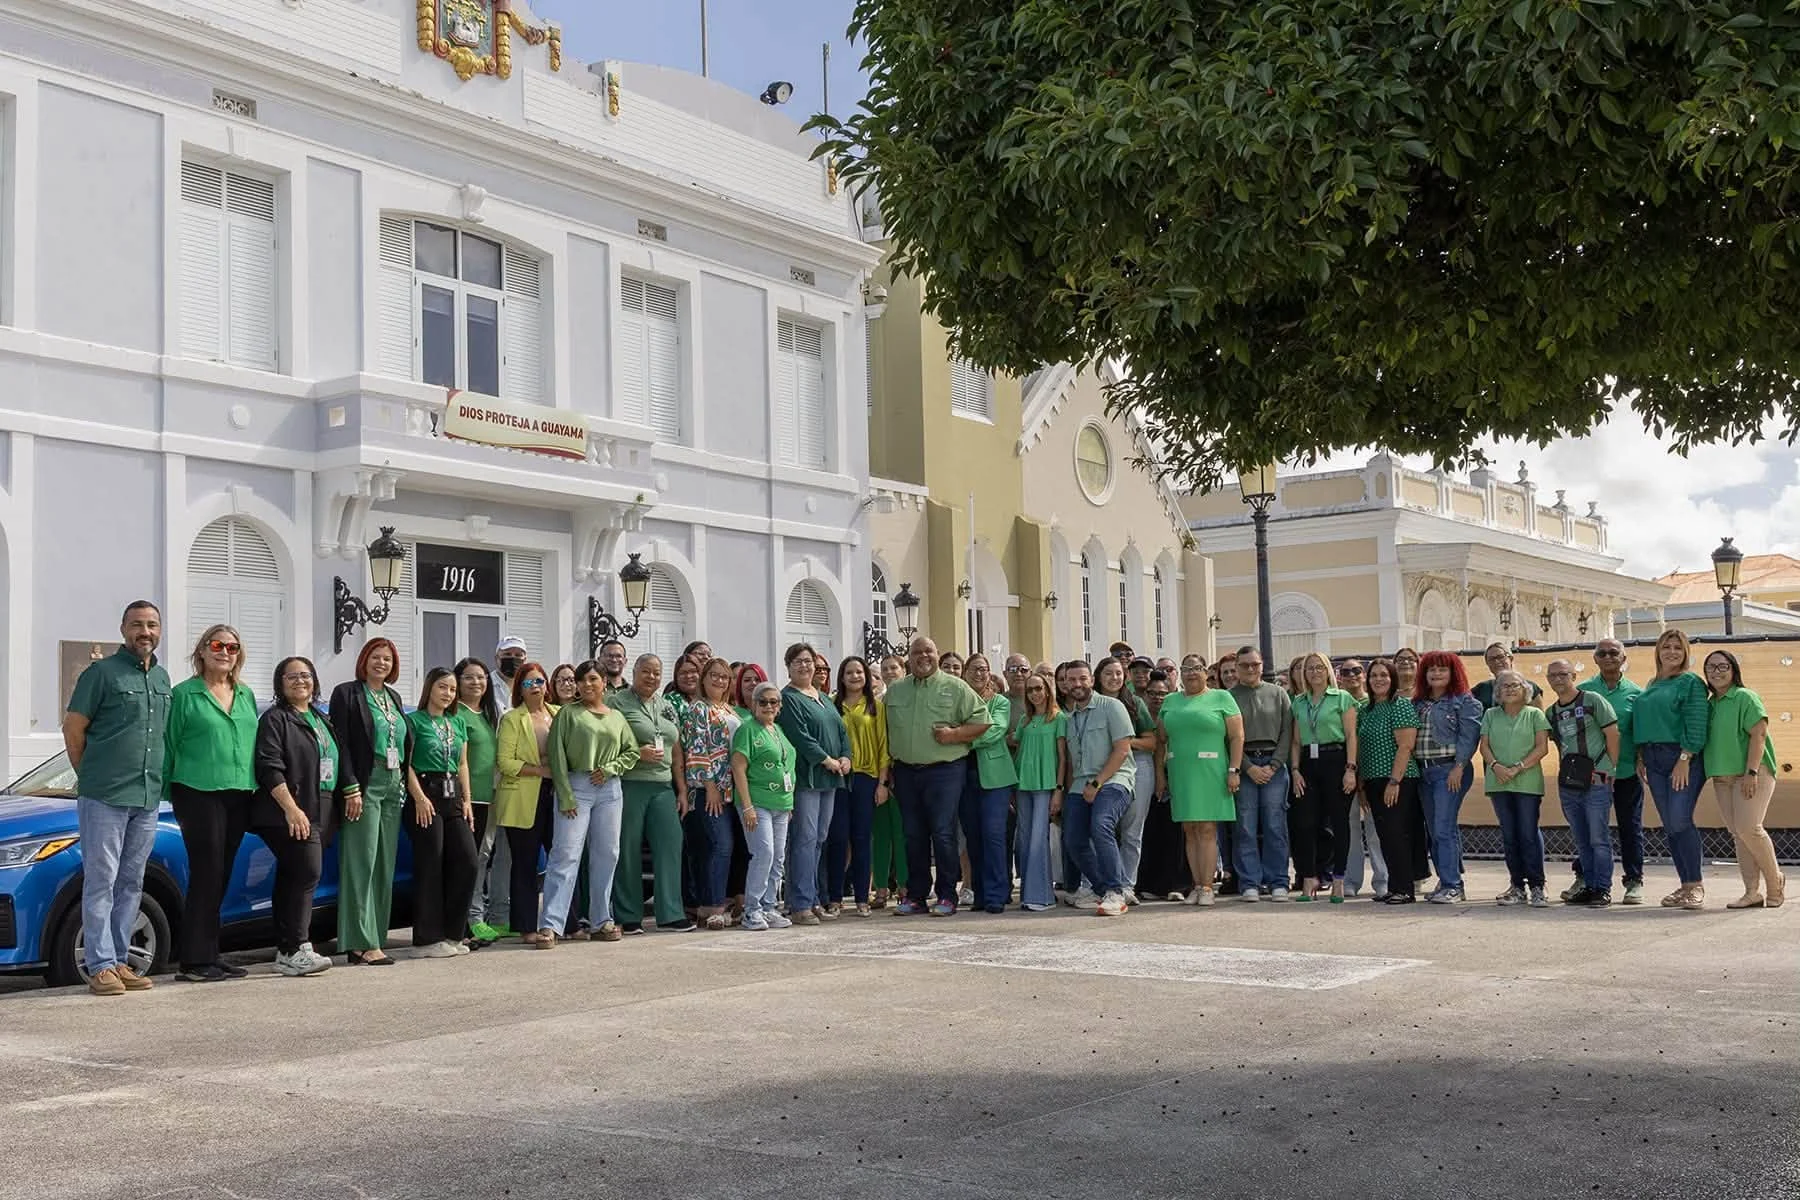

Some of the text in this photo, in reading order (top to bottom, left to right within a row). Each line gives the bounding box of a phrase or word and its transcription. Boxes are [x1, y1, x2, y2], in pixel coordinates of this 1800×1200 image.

[459, 405, 584, 440] DIOS PROTEJA A GUAYAMA
[440, 566, 476, 593] 1916
